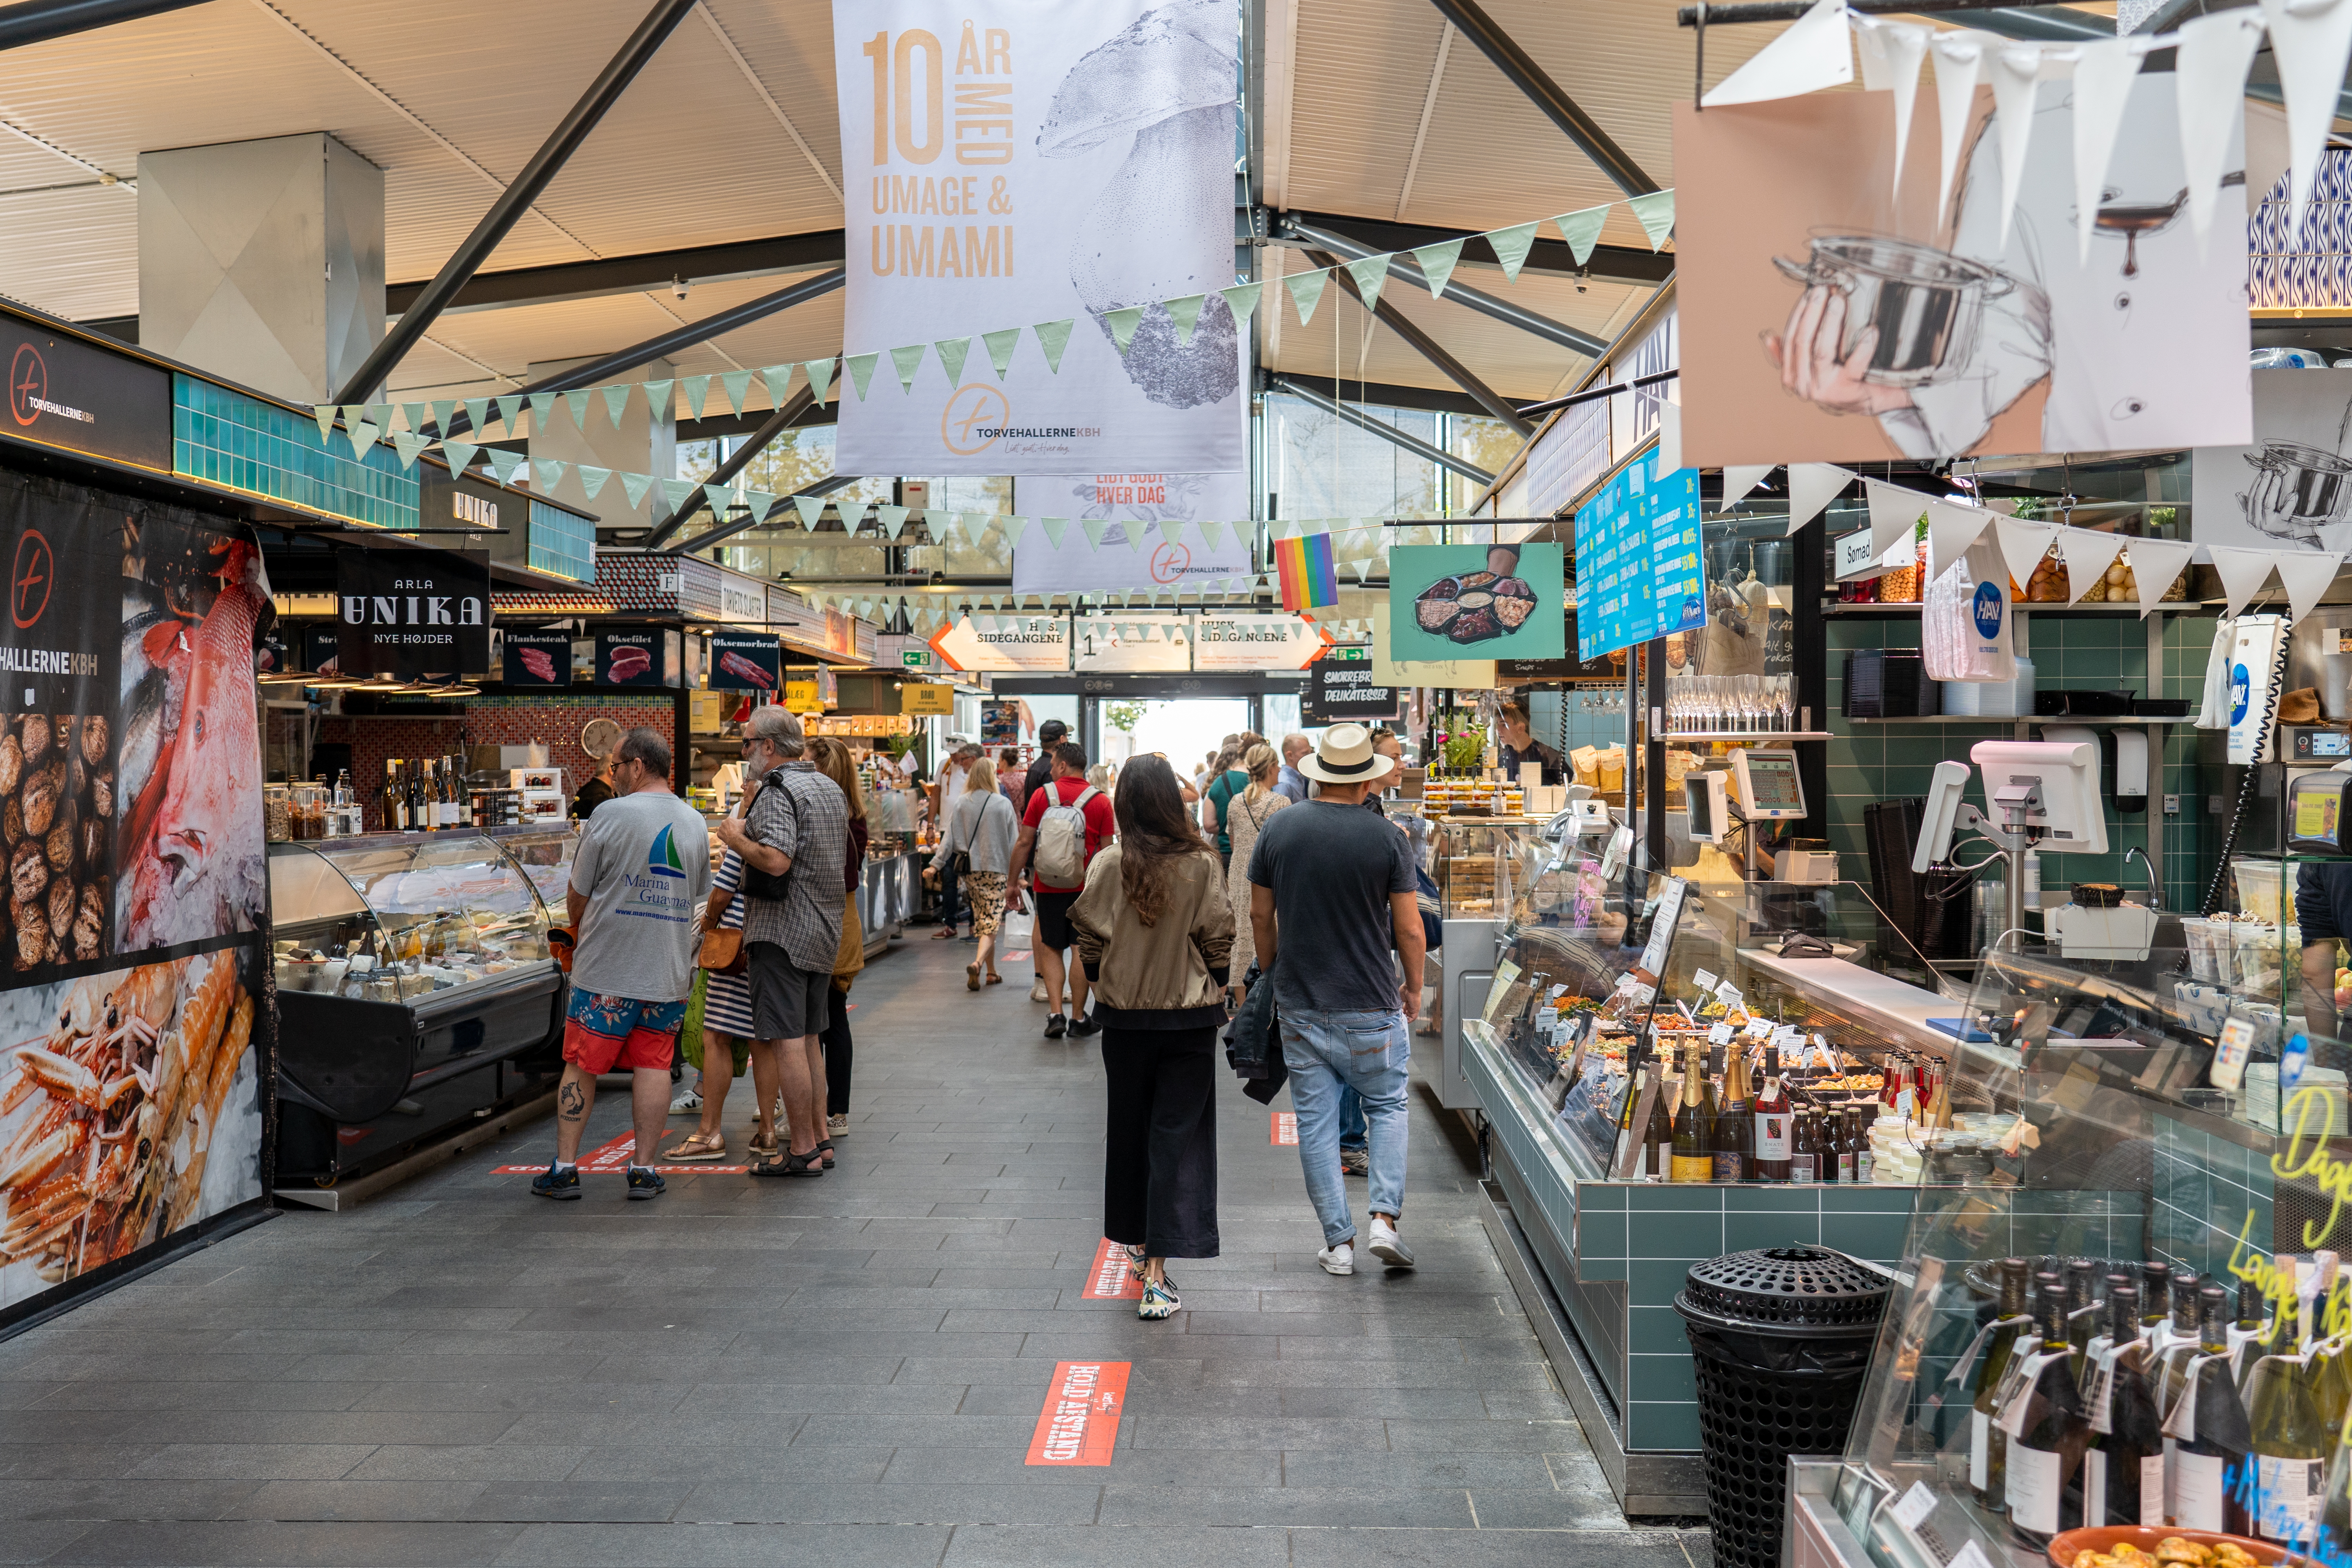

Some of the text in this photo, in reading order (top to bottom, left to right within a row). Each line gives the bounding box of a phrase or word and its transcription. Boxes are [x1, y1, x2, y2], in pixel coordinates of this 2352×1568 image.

[863, 18, 1013, 167] 10 ÅR
[955, 83, 1013, 165] MED
[872, 175, 1014, 216] UMAGE &
[872, 224, 1014, 278] UMAMI
[29, 396, 94, 424] TORVEHALLERNEKBH
[977, 428, 1100, 438] TORVEHALLERNEKBH
[1096, 486, 1165, 504] HVER DAG
[452, 492, 498, 529] UNIKA
[395, 580, 433, 589] ARLA
[666, 576, 673, 588] F
[343, 597, 483, 625] UNIKA
[724, 588, 761, 620] TORVETS SLAGTER
[1976, 601, 2000, 620] HAV
[374, 634, 453, 644] NYE HØJDER
[507, 634, 568, 644] Flankesteak
[607, 635, 652, 644] Oksefilet
[1084, 634, 1096, 655] 1
[786, 687, 804, 699] ÅLÆG
[921, 690, 935, 699] BRØD
[1325, 688, 1388, 702] DELIKATESSER
[621, 874, 670, 890] Marina
[640, 889, 690, 911] Guaymas
[1043, 1365, 1100, 1460] HOLD AFSTAND
